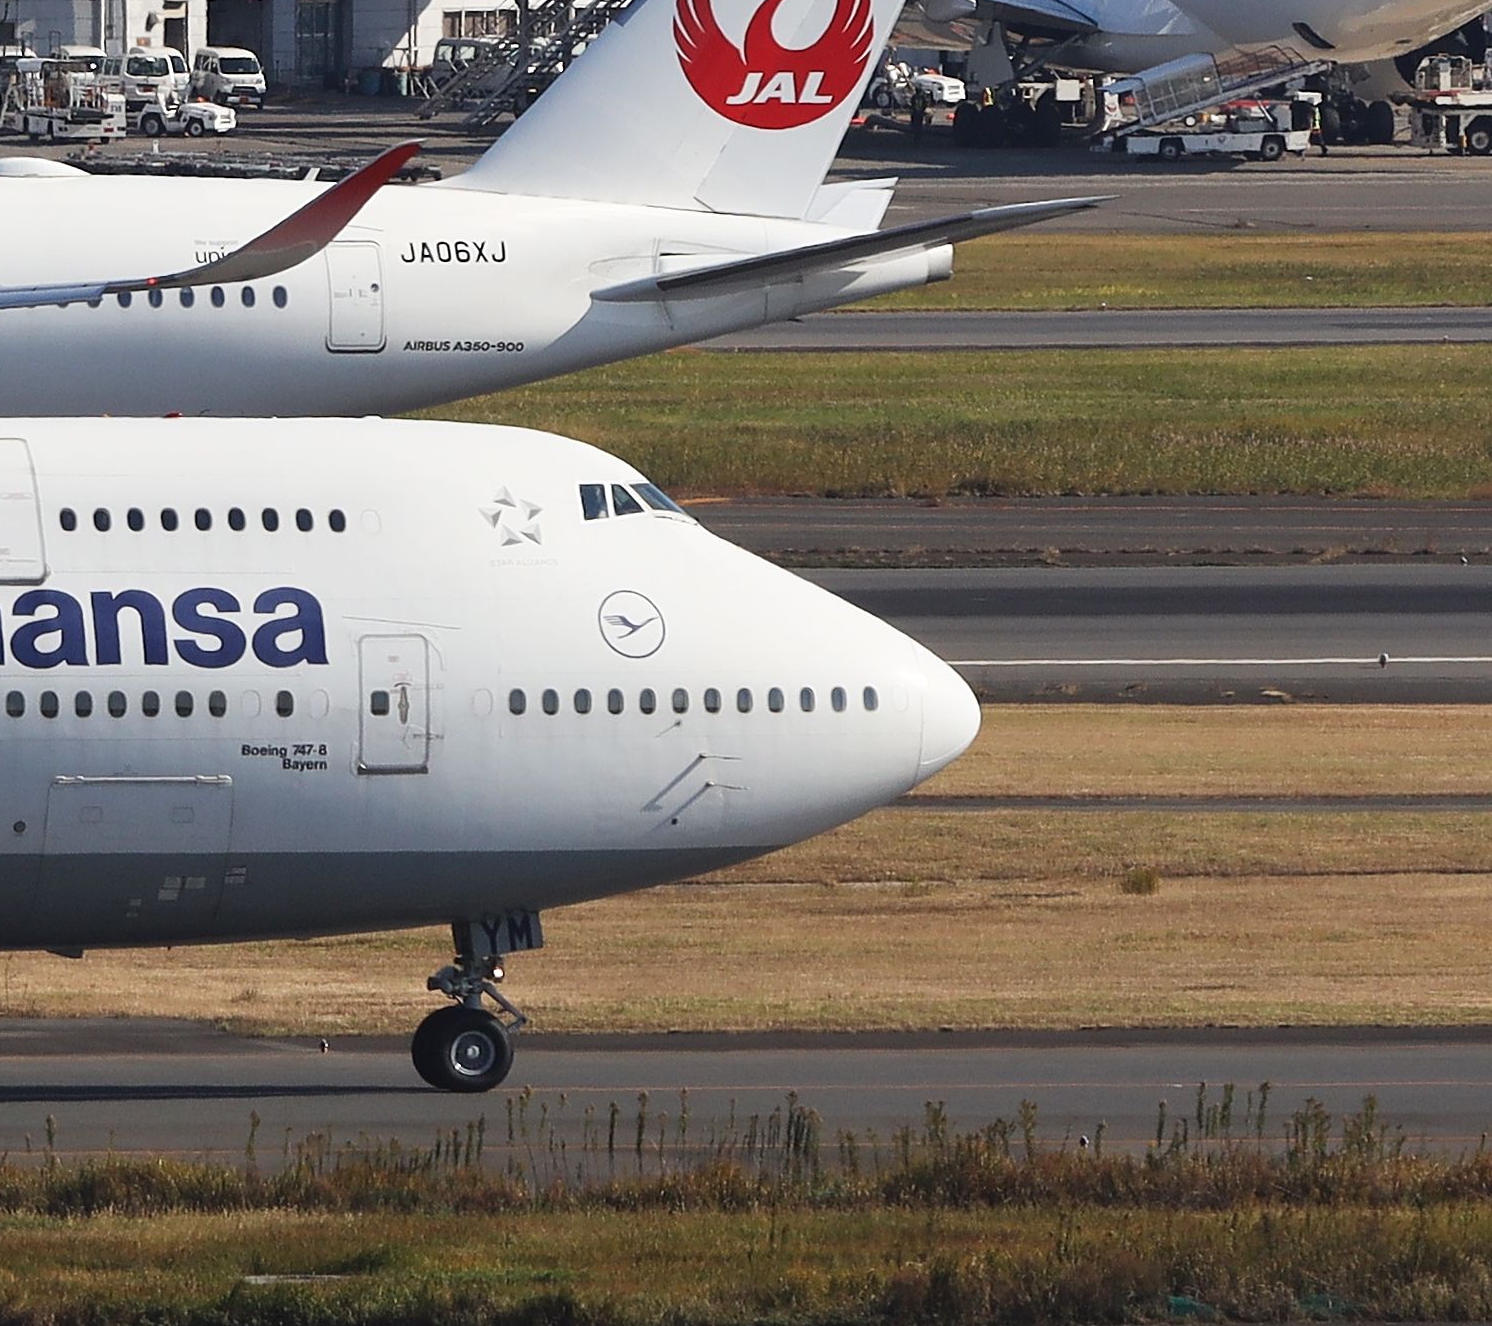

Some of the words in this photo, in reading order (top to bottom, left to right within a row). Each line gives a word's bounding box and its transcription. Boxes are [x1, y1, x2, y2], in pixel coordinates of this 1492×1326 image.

[725, 71, 833, 105] JAL
[401, 241, 506, 263] JA06XJ
[403, 340, 451, 352] AIRBUS
[452, 341, 524, 352] A350-900
[241, 744, 288, 758] Boeing
[292, 744, 327, 756] 747-8
[282, 758, 327, 772] Bayern
[482, 915, 534, 954] YM
